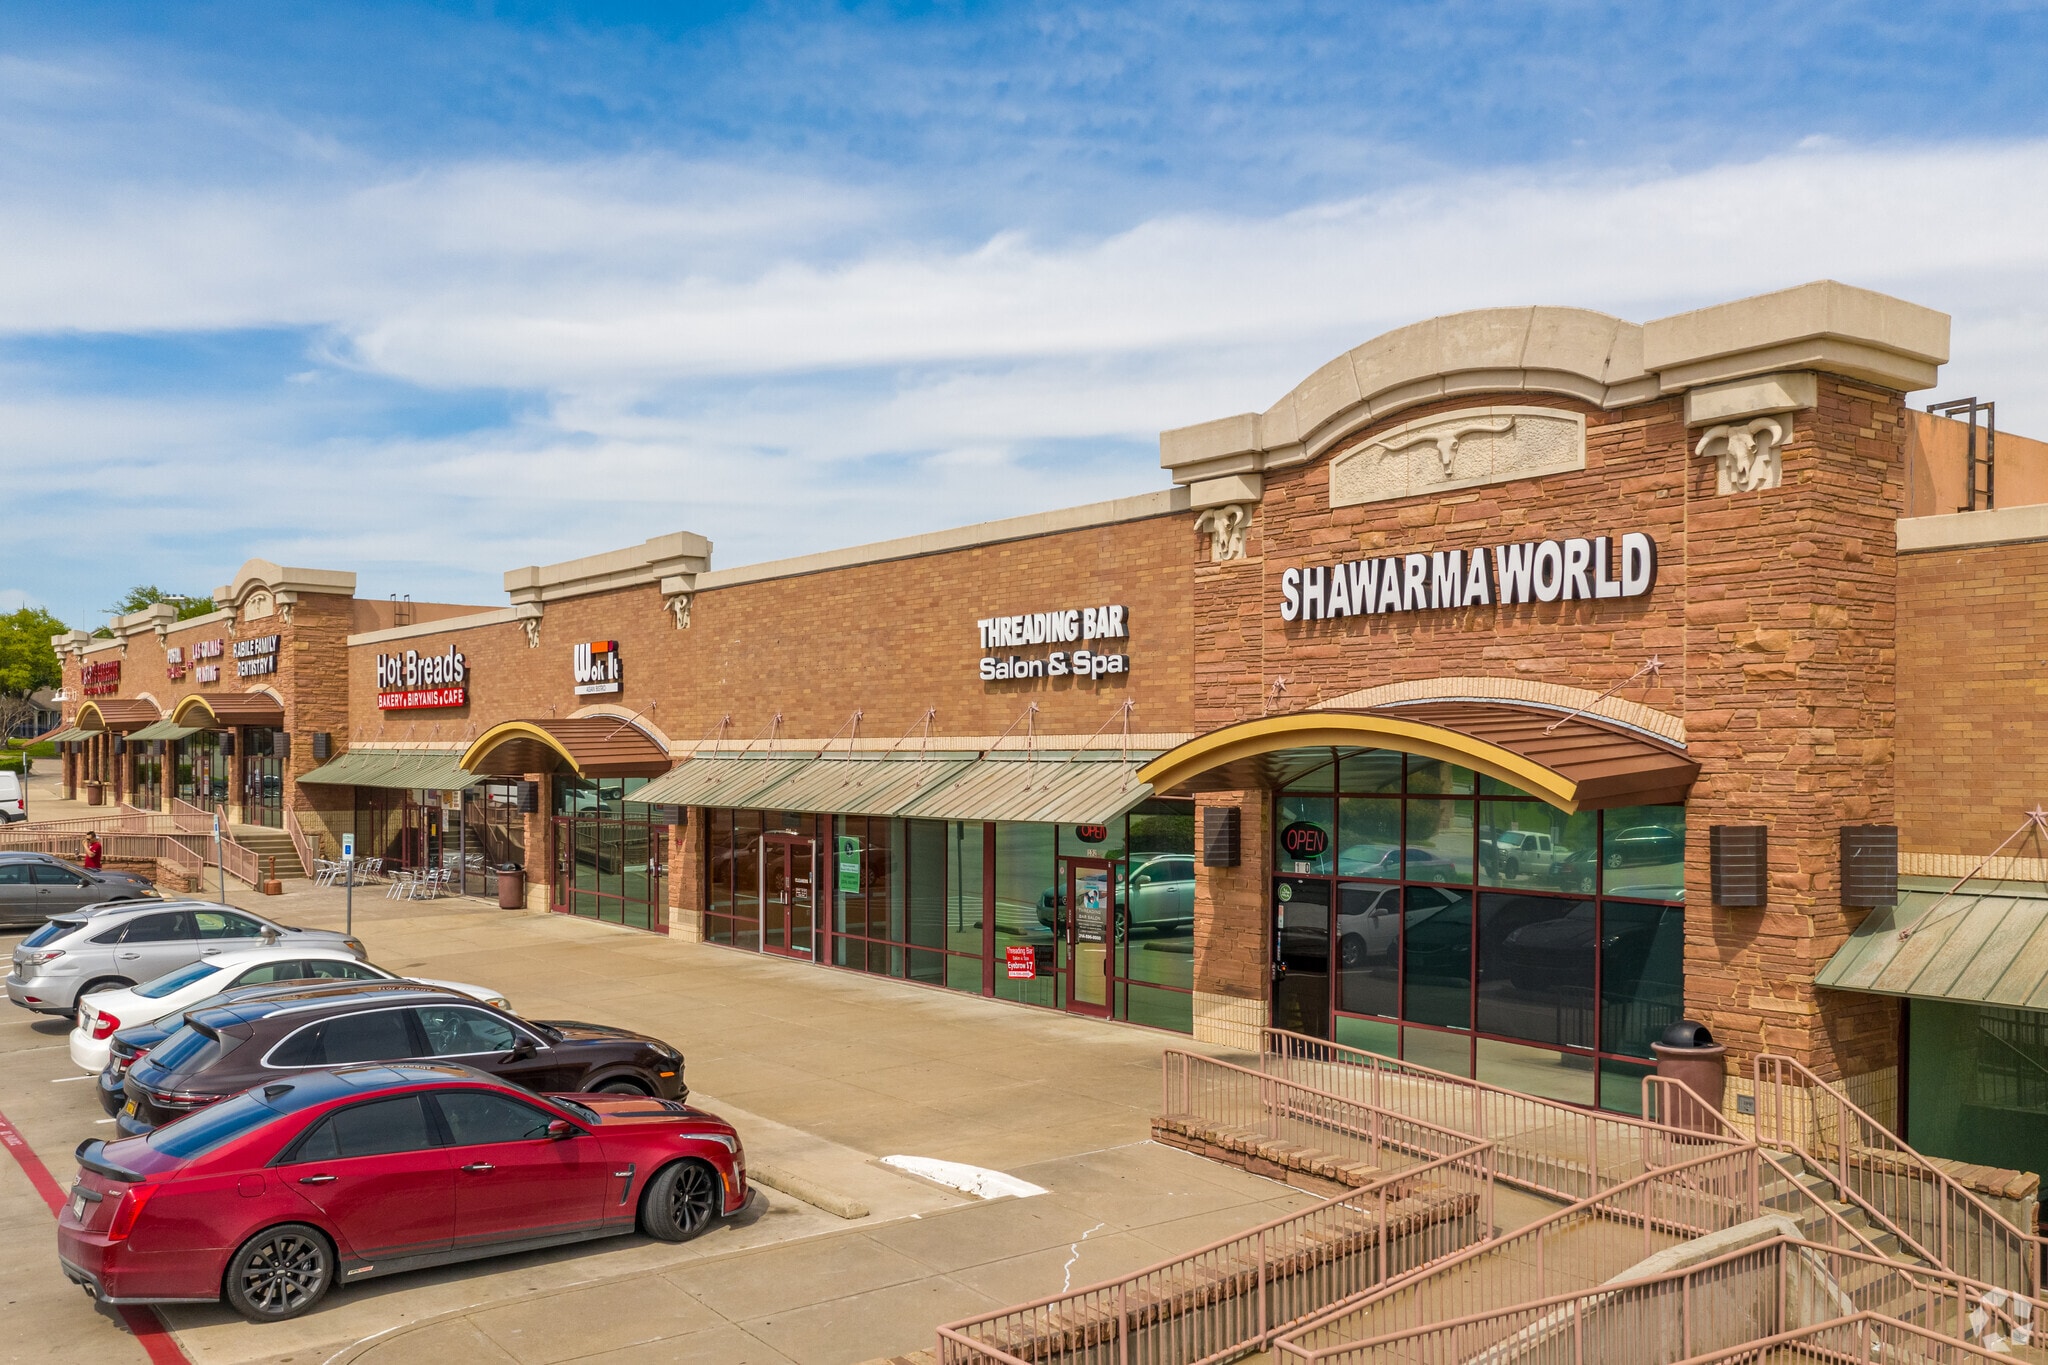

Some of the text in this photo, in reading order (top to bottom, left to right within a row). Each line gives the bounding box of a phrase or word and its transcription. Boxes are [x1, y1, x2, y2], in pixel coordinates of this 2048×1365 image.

[1280, 532, 1652, 621] SHAWARMA WORLD
[977, 605, 1124, 649] THREADING BAR
[255, 635, 277, 655] FAMILY
[238, 657, 268, 677] DENTISTRY
[377, 644, 464, 689] Hot Breads
[574, 642, 619, 683] Wok It
[979, 655, 1043, 681] Salon
[1047, 652, 1069, 676] &
[378, 689, 464, 708] BAKERY BIRYANIS CAFE
[1081, 825, 1107, 839] OPEN
[1287, 829, 1325, 852] OPEN
[1006, 947, 1026, 956] Threading
[1008, 962, 1026, 971] Eyebrow
